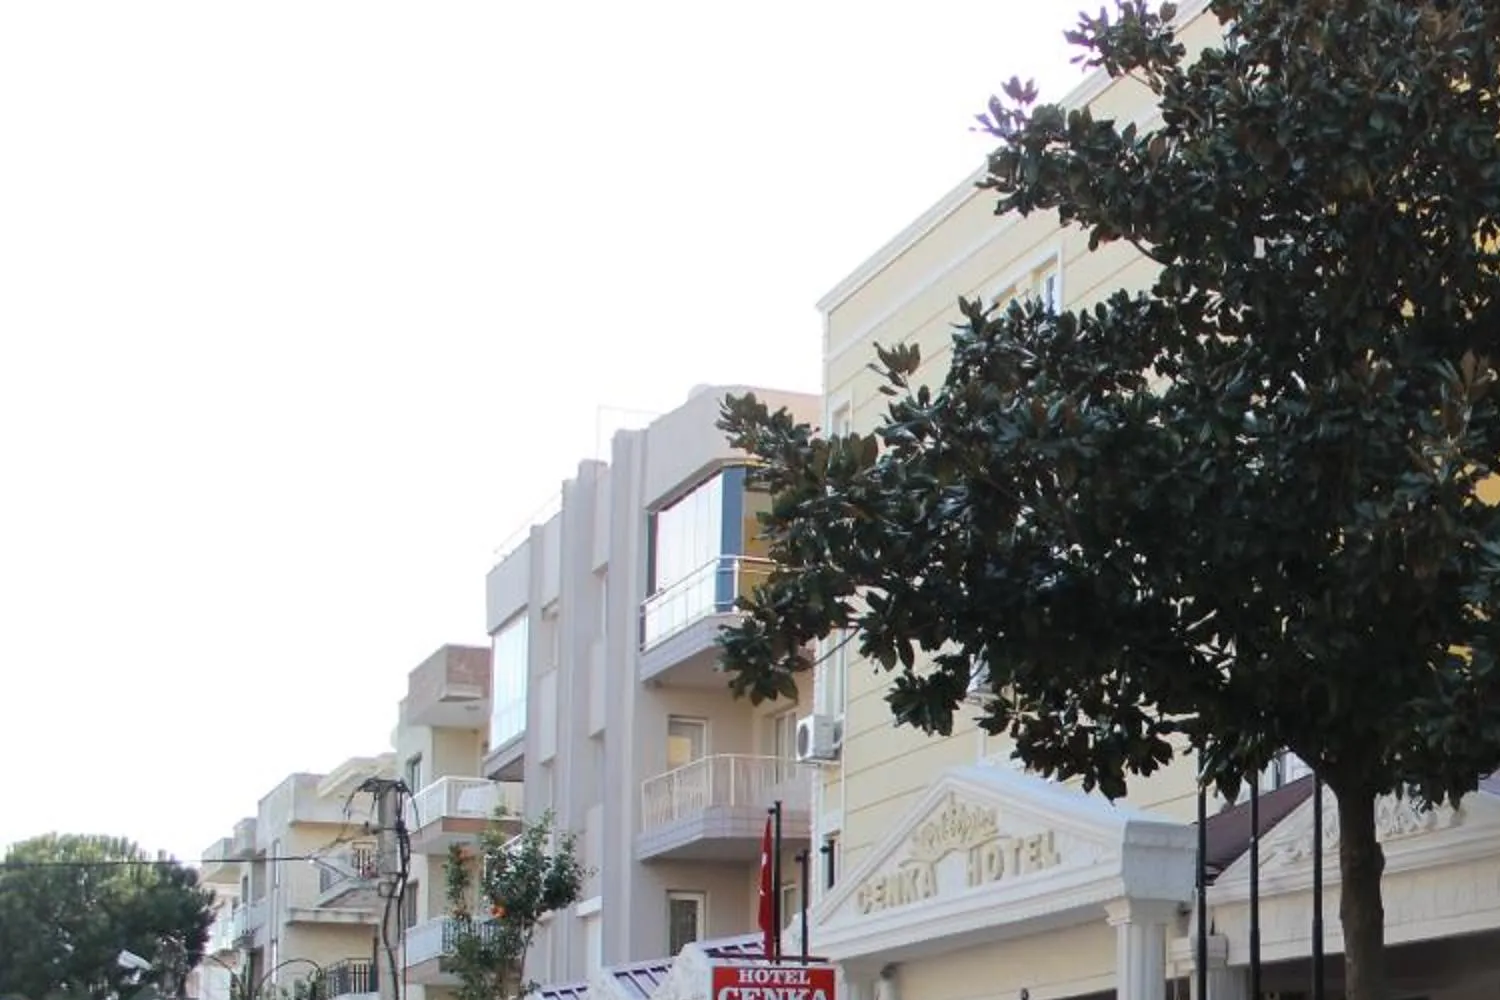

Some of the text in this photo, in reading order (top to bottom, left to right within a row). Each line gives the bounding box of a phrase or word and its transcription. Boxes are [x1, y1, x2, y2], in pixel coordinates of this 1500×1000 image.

[857, 830, 1061, 914] CENKA HOTEL
[737, 969, 811, 985] HOTEL
